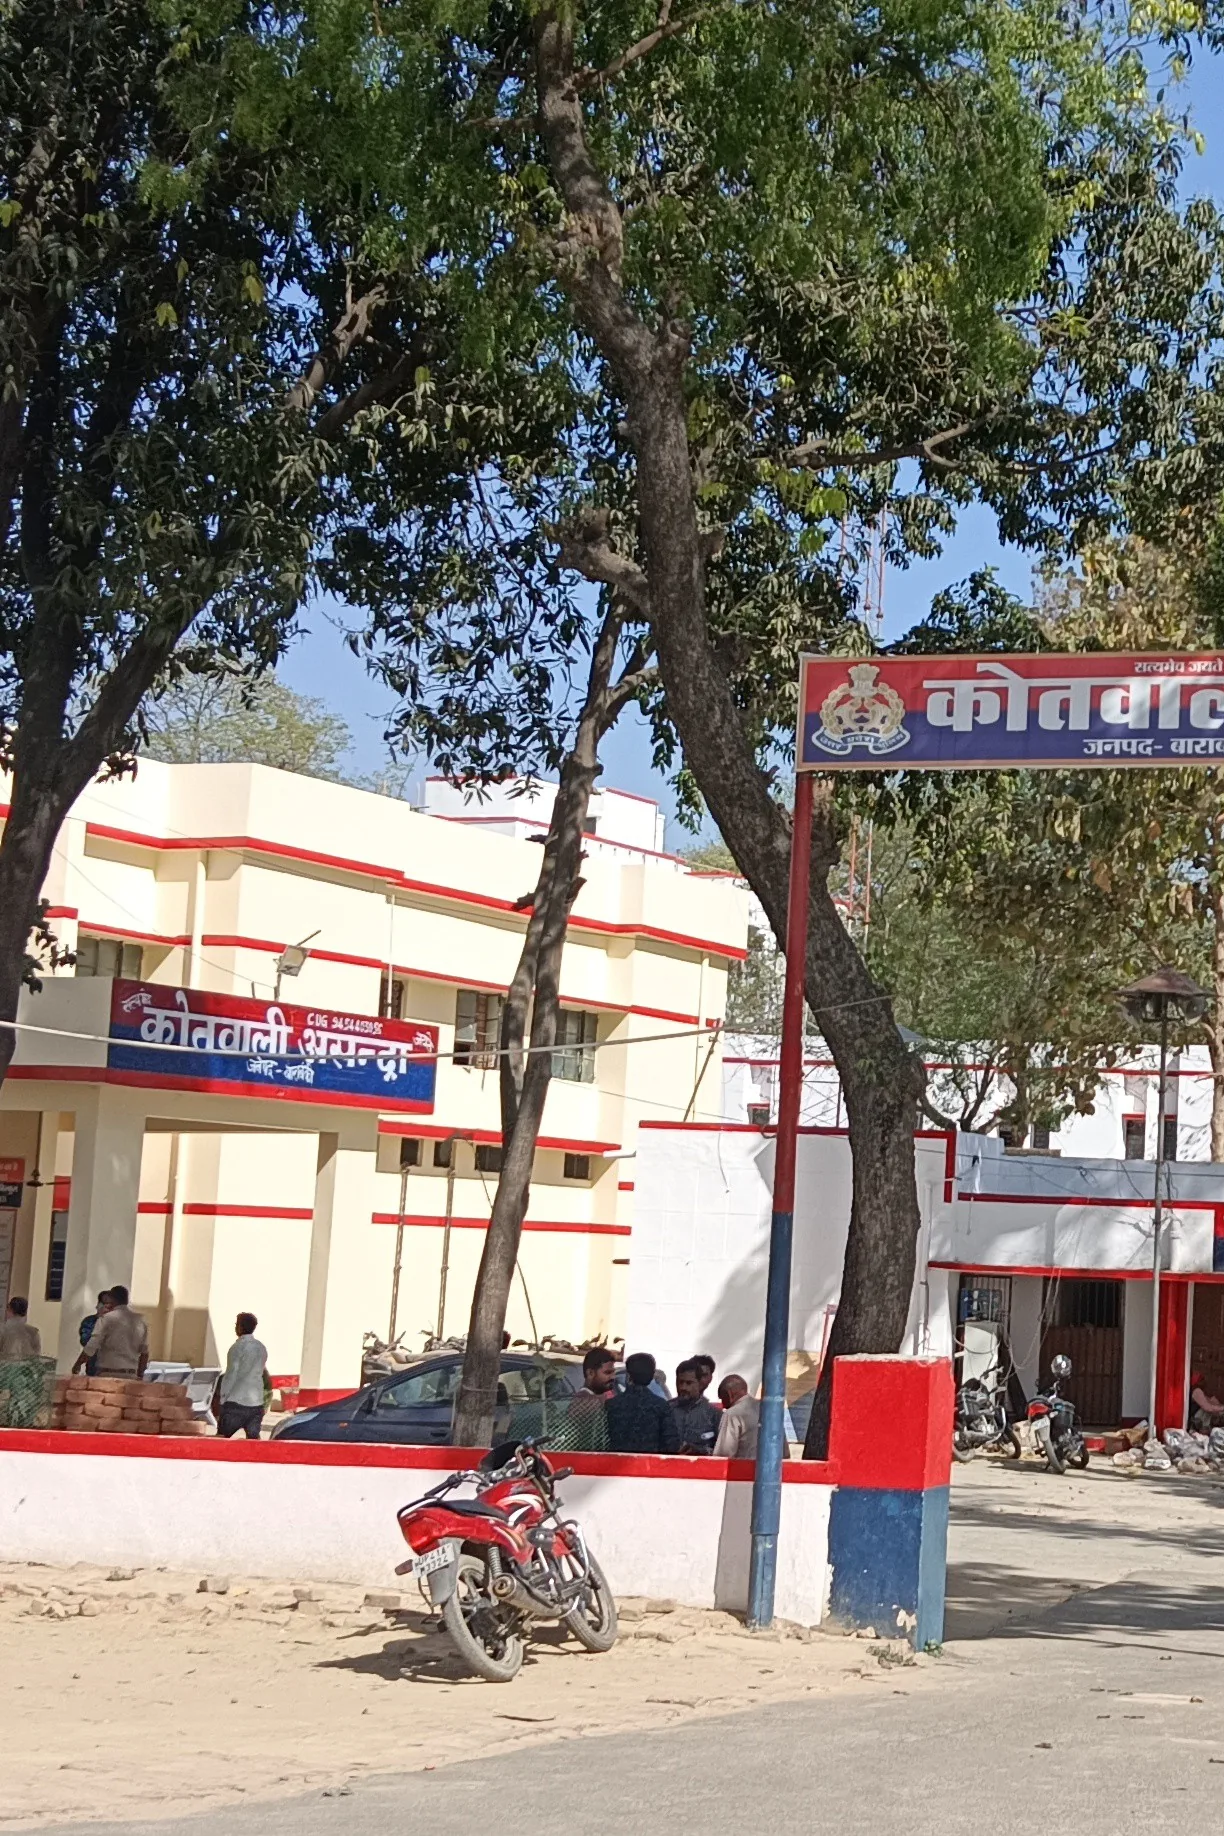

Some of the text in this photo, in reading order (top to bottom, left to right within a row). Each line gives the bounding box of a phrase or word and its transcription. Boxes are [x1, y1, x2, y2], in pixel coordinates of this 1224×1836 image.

[1134, 658, 1223, 673] सत्यमेव जयते
[140, 990, 413, 1082] कोतवाली असन्द्रा
